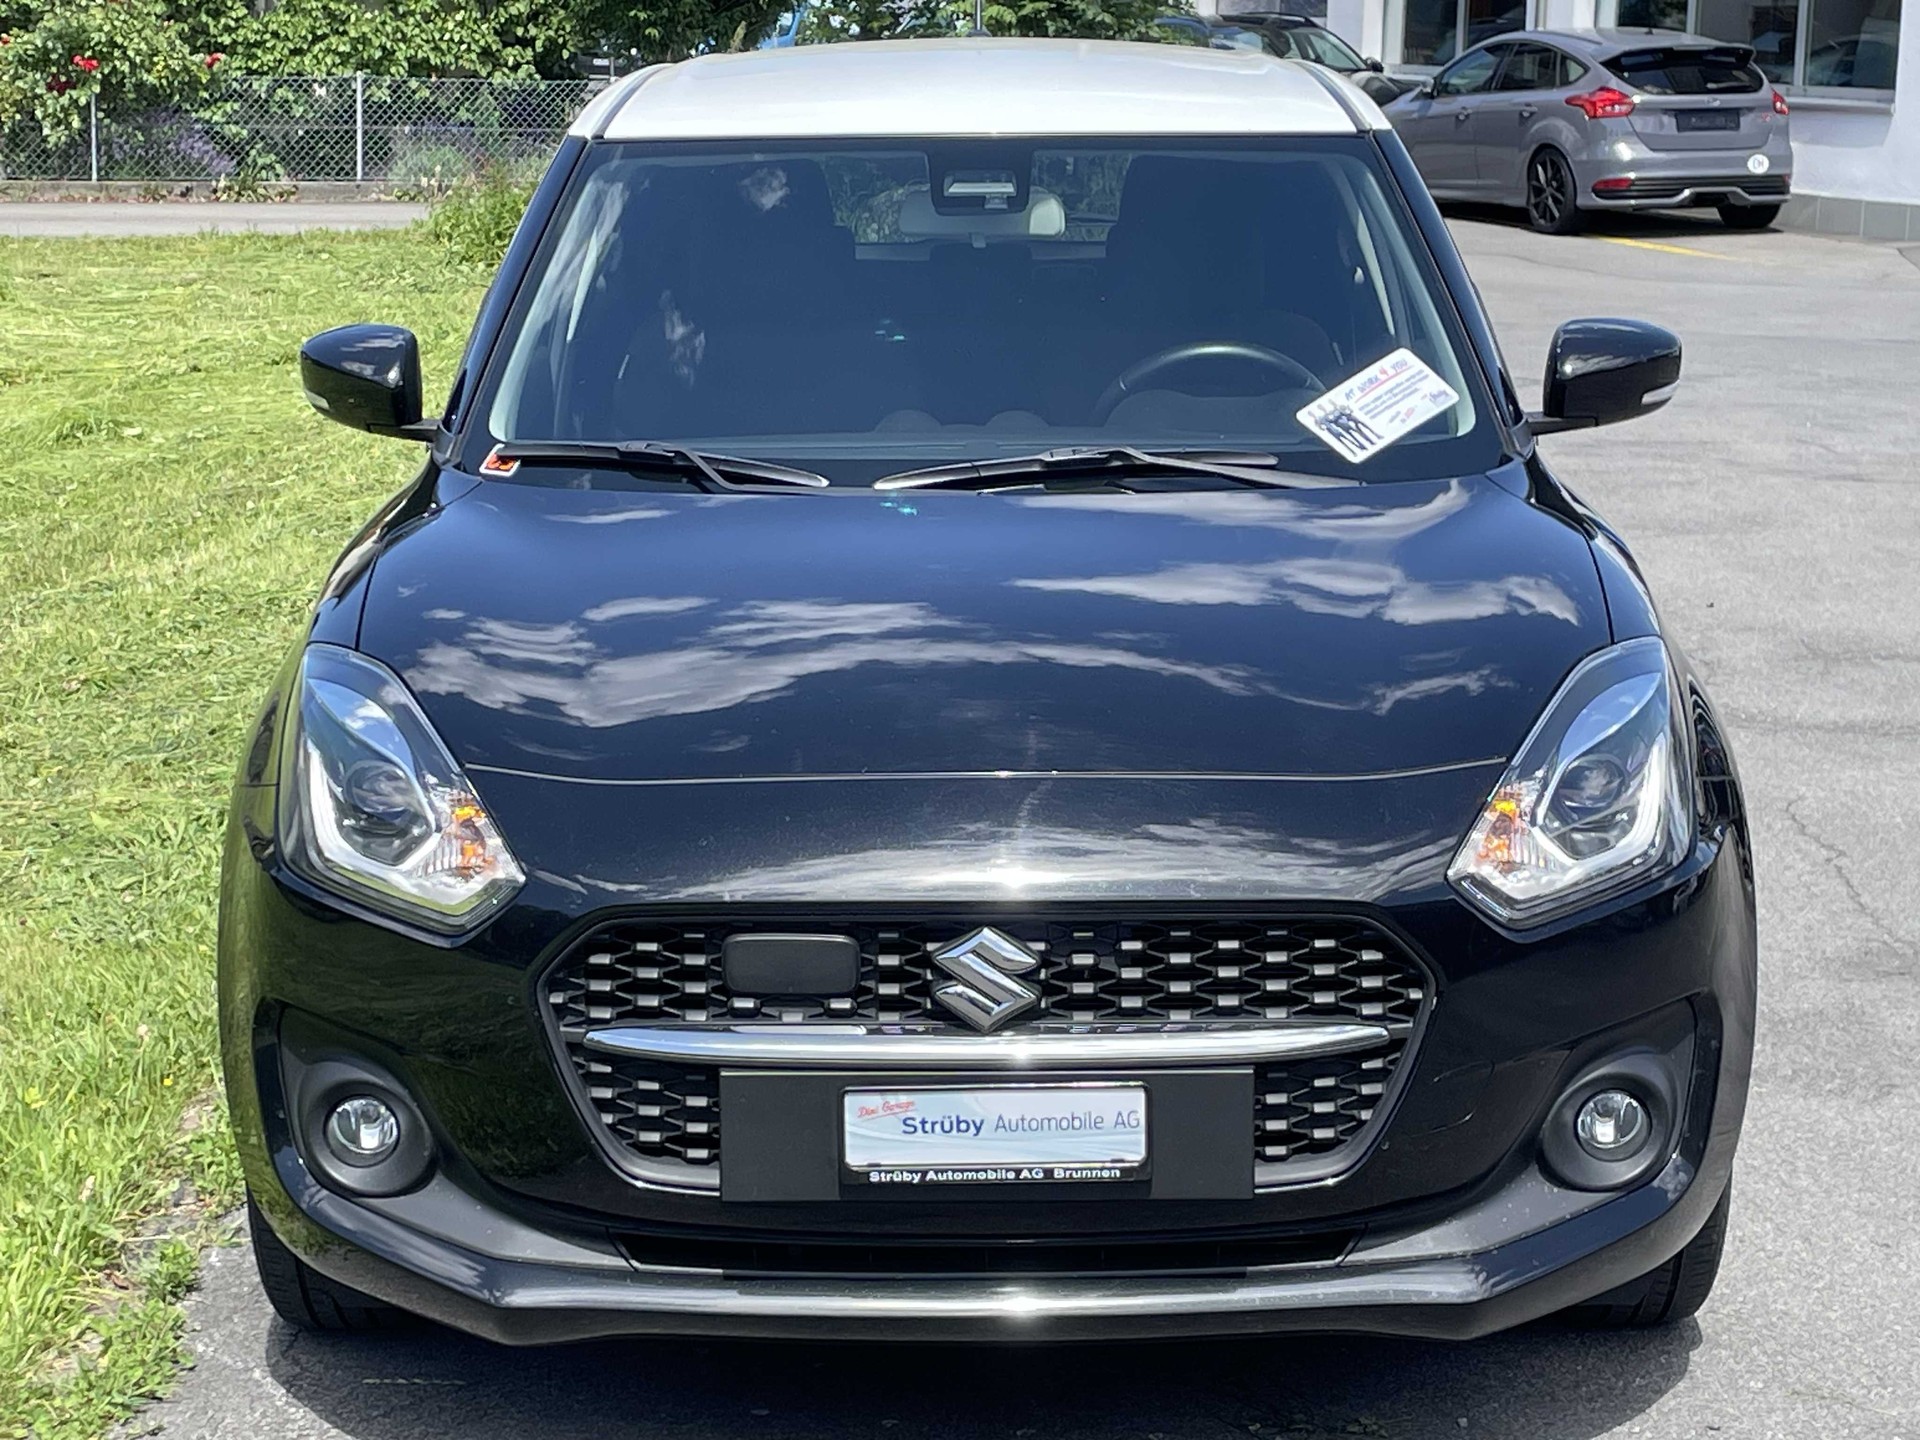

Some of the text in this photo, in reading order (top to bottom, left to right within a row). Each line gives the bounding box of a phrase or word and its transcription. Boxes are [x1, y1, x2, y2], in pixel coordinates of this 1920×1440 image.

[1391, 358, 1408, 373] YOU
[902, 1110, 1140, 1136] Strüby Automobile AG
[869, 1167, 1121, 1183] Strüby Automobile AG Brunnen
